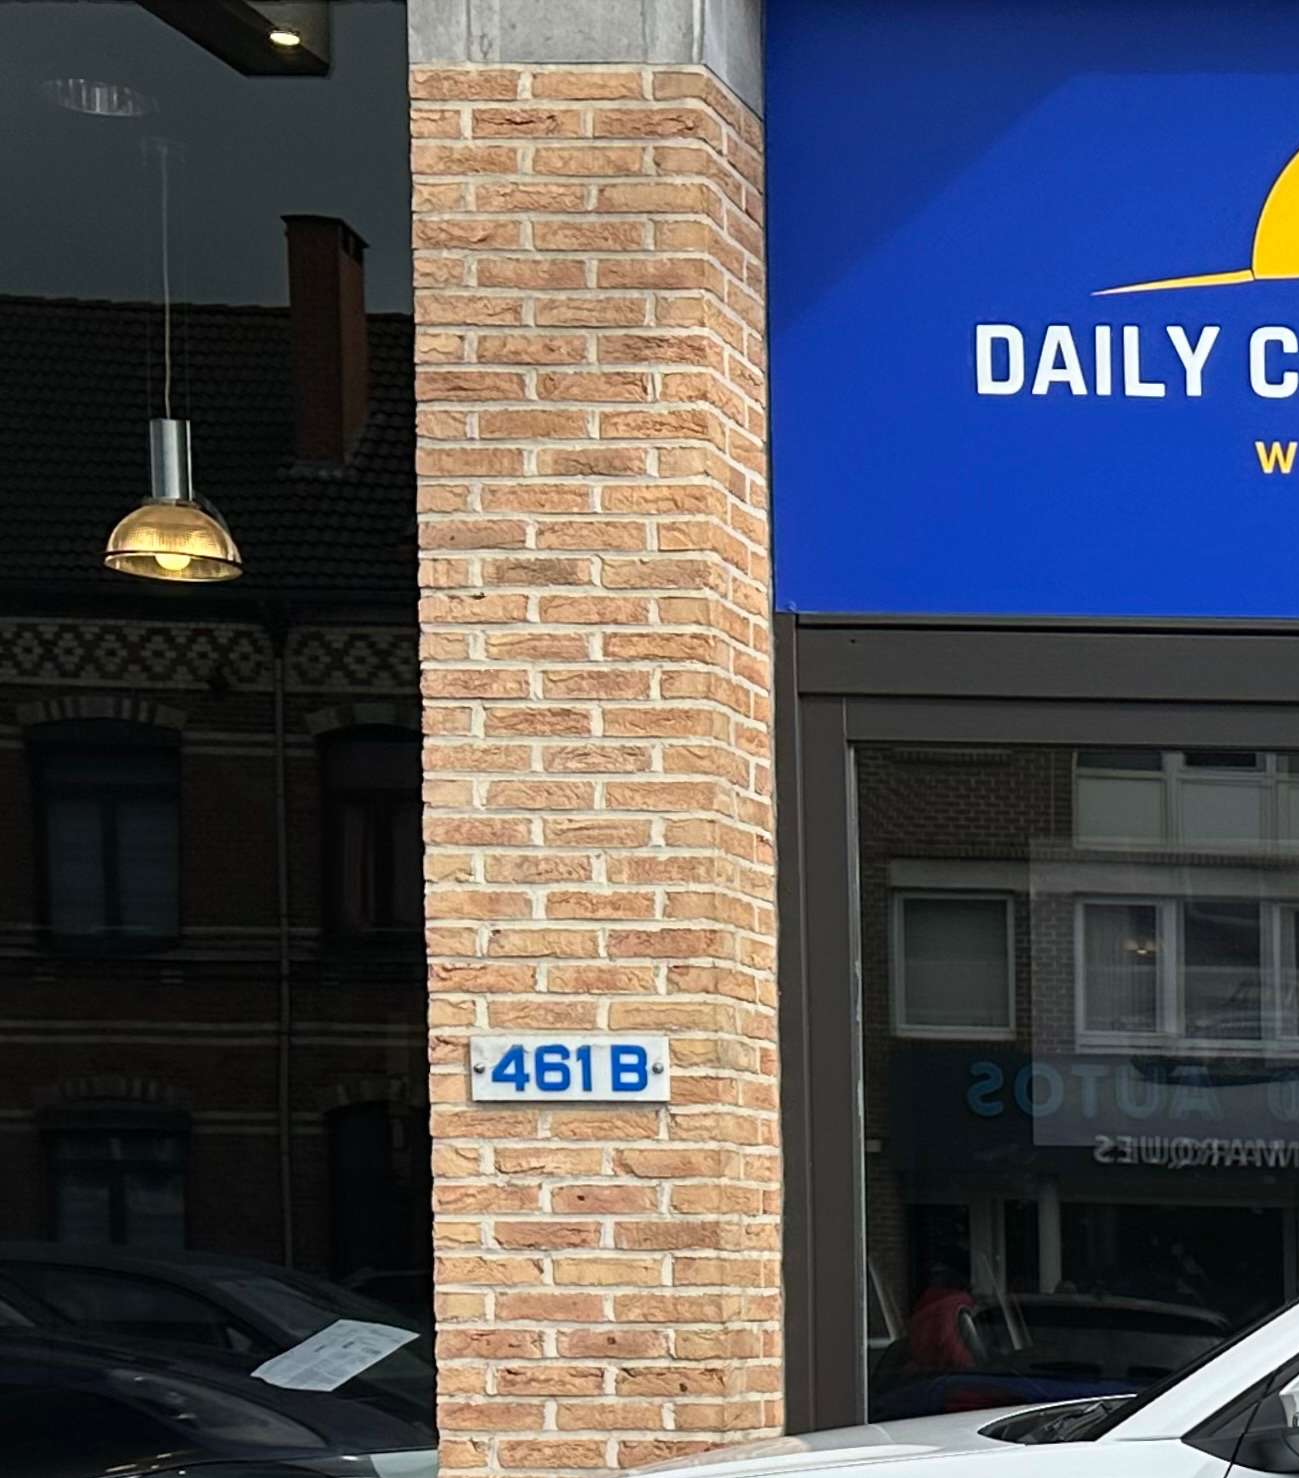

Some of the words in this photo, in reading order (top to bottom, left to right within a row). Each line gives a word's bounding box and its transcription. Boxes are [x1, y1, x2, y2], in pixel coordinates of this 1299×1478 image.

[976, 324, 1221, 398] DAILY
[490, 1044, 593, 1092] 461
[610, 1043, 649, 1093] B
